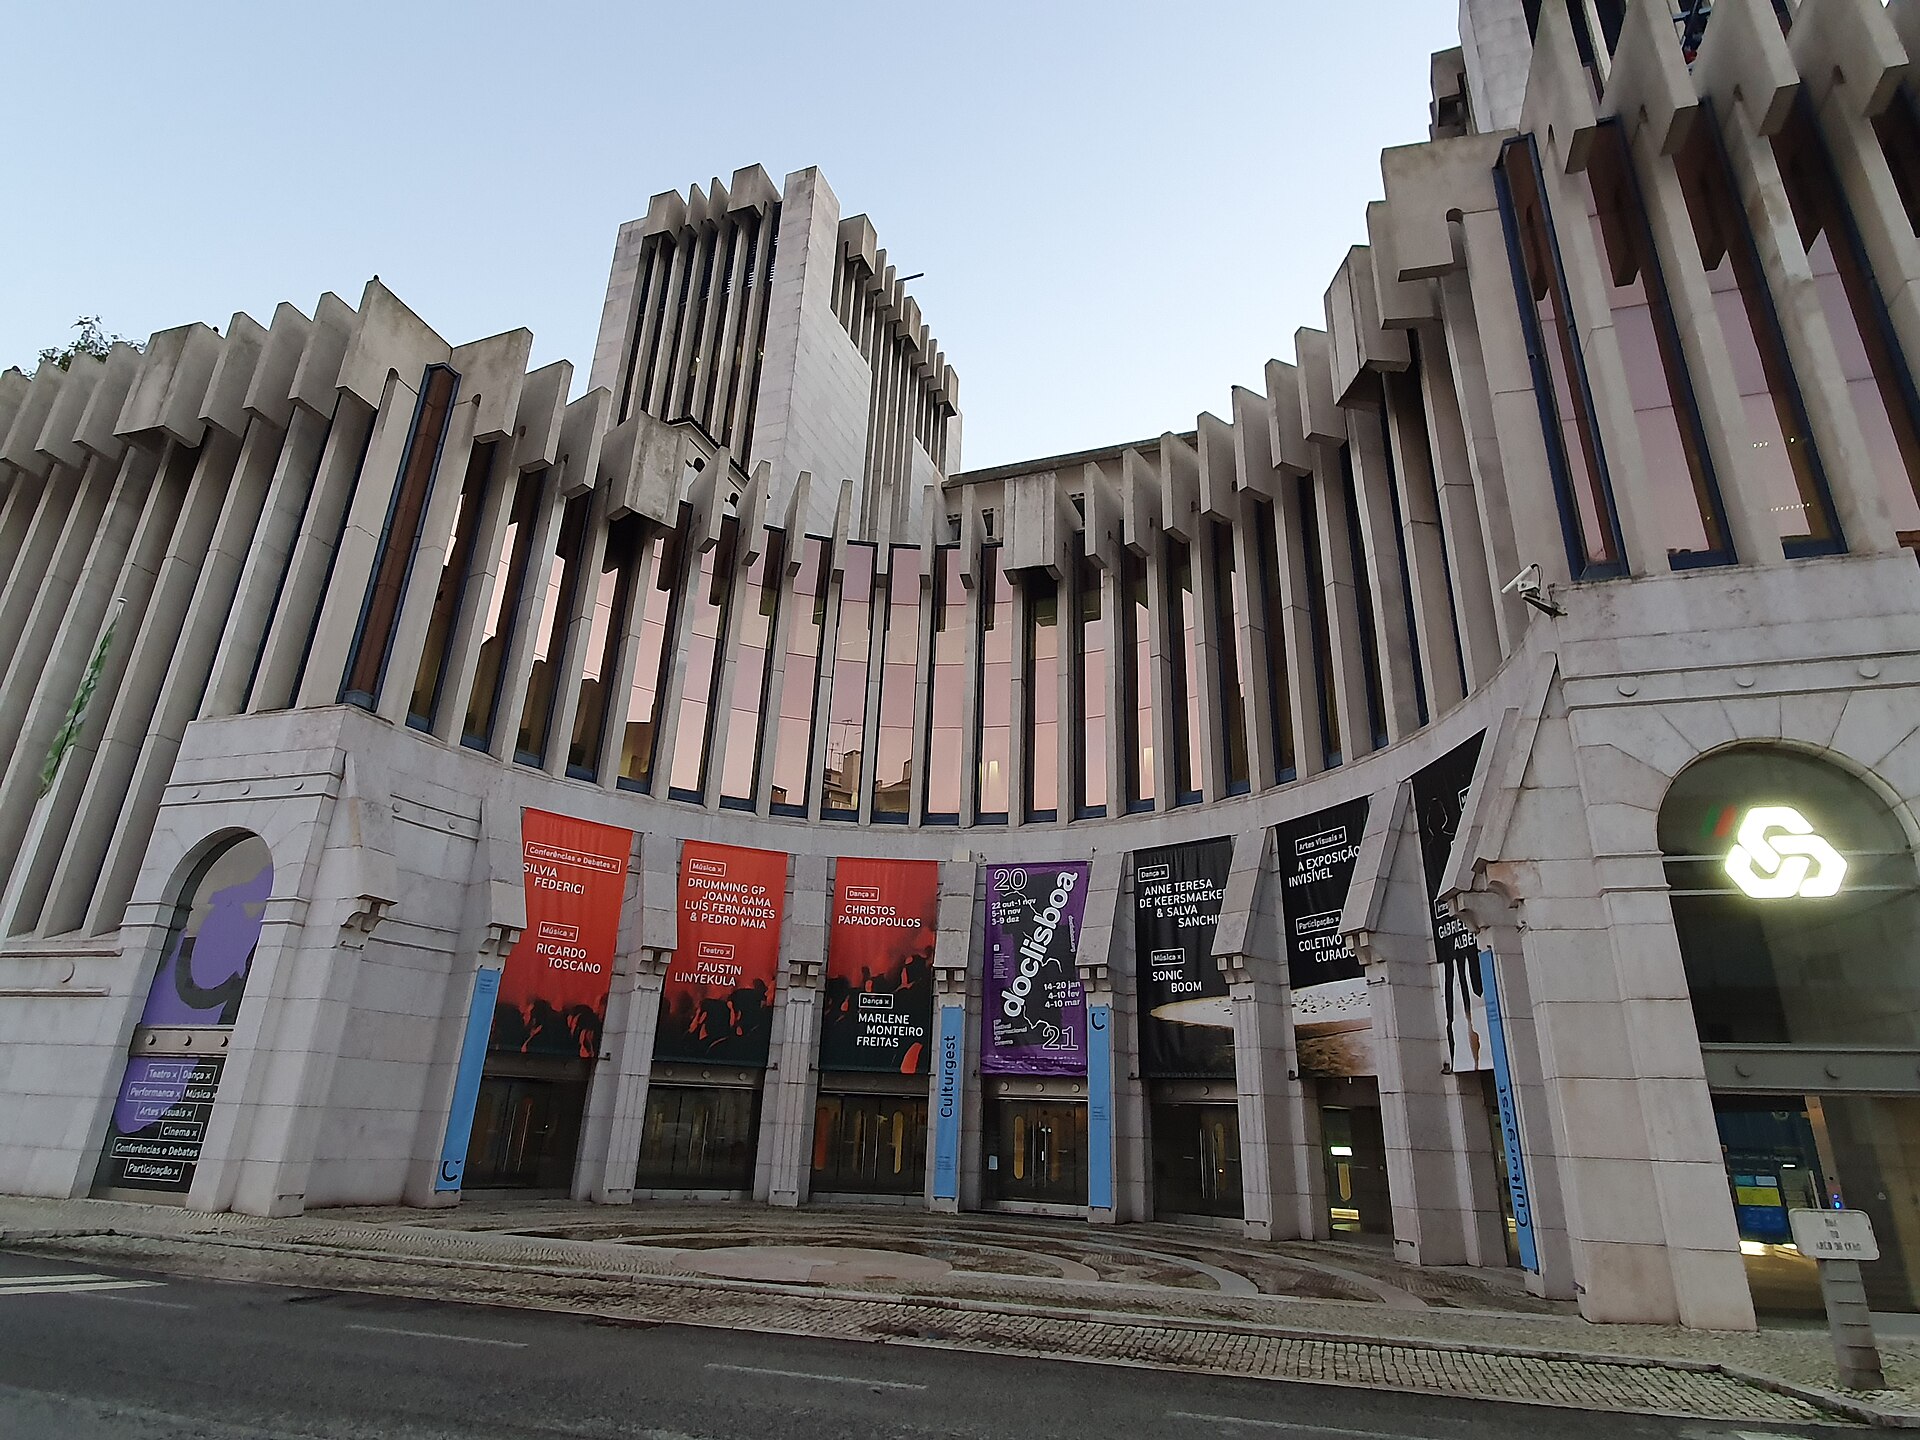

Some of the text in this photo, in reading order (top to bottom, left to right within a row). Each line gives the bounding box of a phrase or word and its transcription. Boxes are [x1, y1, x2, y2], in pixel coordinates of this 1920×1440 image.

[529, 846, 576, 862] Conferências
[523, 862, 558, 878] SILVIA
[1298, 861, 1304, 872] A
[534, 876, 585, 895] FEDERICI
[993, 867, 1028, 891] 20
[1288, 867, 1334, 888] INVISÍVEL
[687, 877, 766, 895] DRUMMING GP
[1144, 878, 1213, 897] ANNE TERESA
[702, 891, 771, 908] JOANA GAMA
[991, 901, 1001, 910] 22
[1139, 897, 1152, 909] DE
[685, 899, 776, 919] LUÍS FERNANDES
[845, 905, 896, 917] CHRISTOS
[1166, 904, 1198, 917] SALVA
[701, 913, 737, 926] PEDRO
[740, 917, 767, 930] MAIA
[838, 916, 921, 928] PAPADOPOULOS
[1178, 913, 1220, 928] SANCHI
[536, 942, 587, 959] RICARDO
[1001, 871, 1079, 1017] doclisboa
[1298, 934, 1343, 952] COLETIVO
[548, 957, 602, 974] TOSCANO
[696, 961, 743, 976] FAUSTIN
[674, 972, 737, 987] LINYEKULA
[1152, 970, 1184, 982] SONIC
[1171, 981, 1202, 993] BOOM
[858, 1013, 910, 1024] MARLENE
[866, 1025, 924, 1037] MONTEIRO
[1042, 1025, 1079, 1051] 21
[856, 1036, 899, 1047] FREITAS
[940, 1035, 957, 1118] Culturgest
[115, 1142, 161, 1156] Conferências
[168, 1145, 198, 1158] Debates
